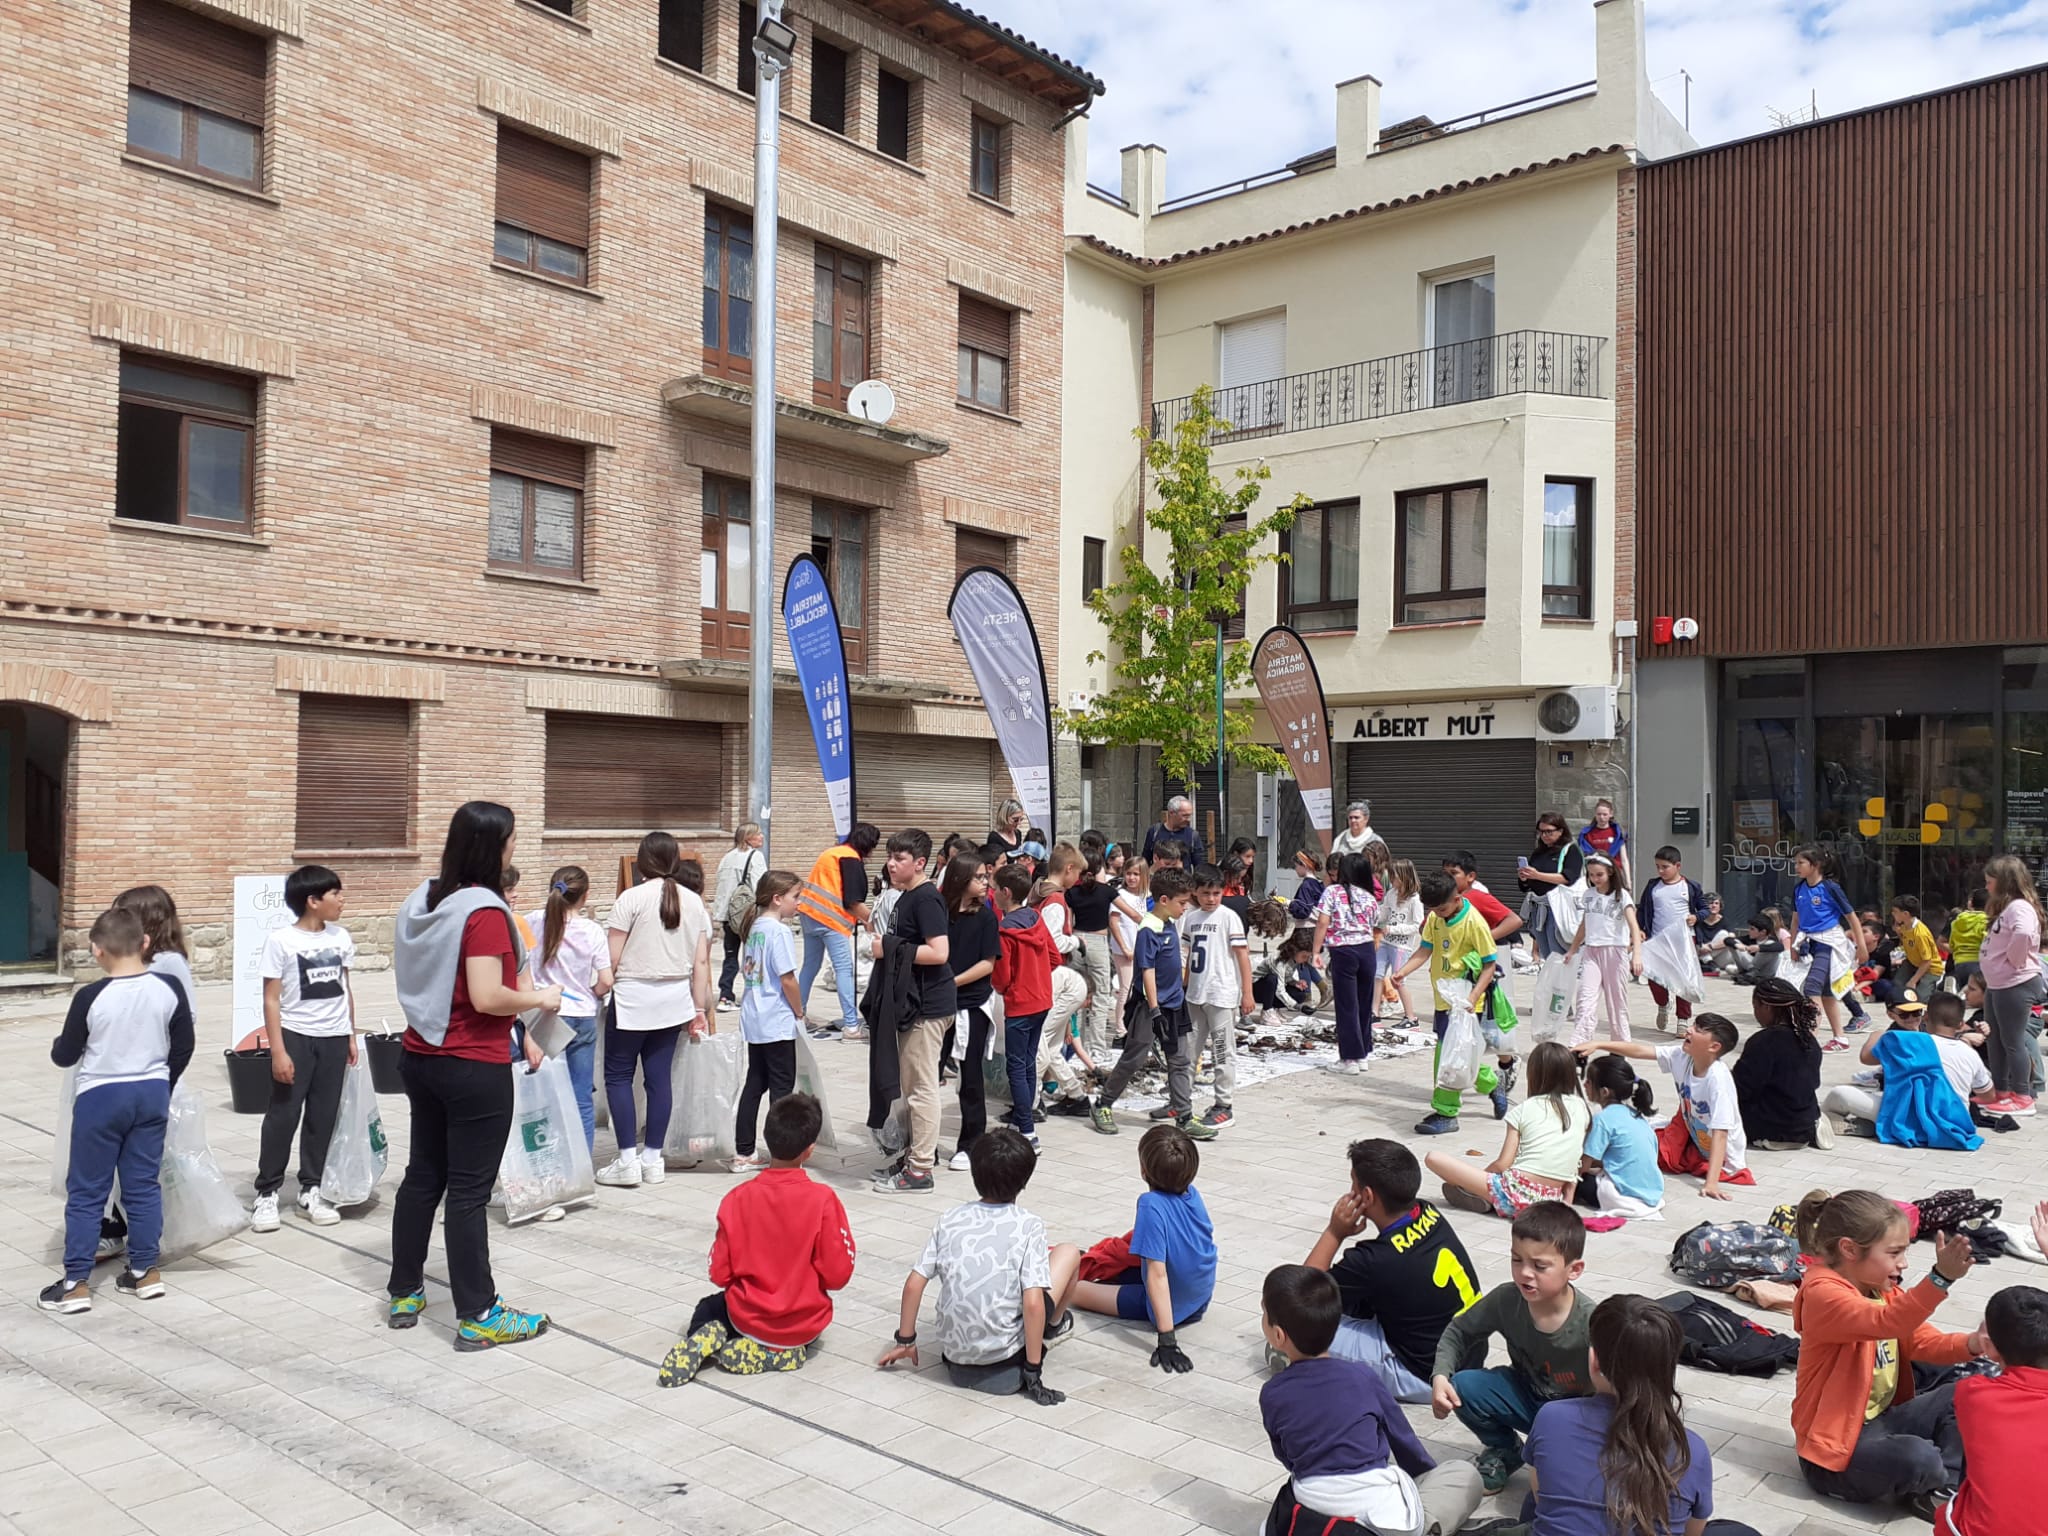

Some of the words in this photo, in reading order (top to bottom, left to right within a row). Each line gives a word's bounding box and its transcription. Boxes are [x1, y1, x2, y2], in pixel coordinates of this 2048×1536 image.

[1353, 716, 1430, 738] ALBERT
[1447, 714, 1495, 736] MUT
[1191, 935, 1208, 974] 5
[1391, 1205, 1440, 1253] RAYAN
[1432, 1248, 1483, 1317] 1
